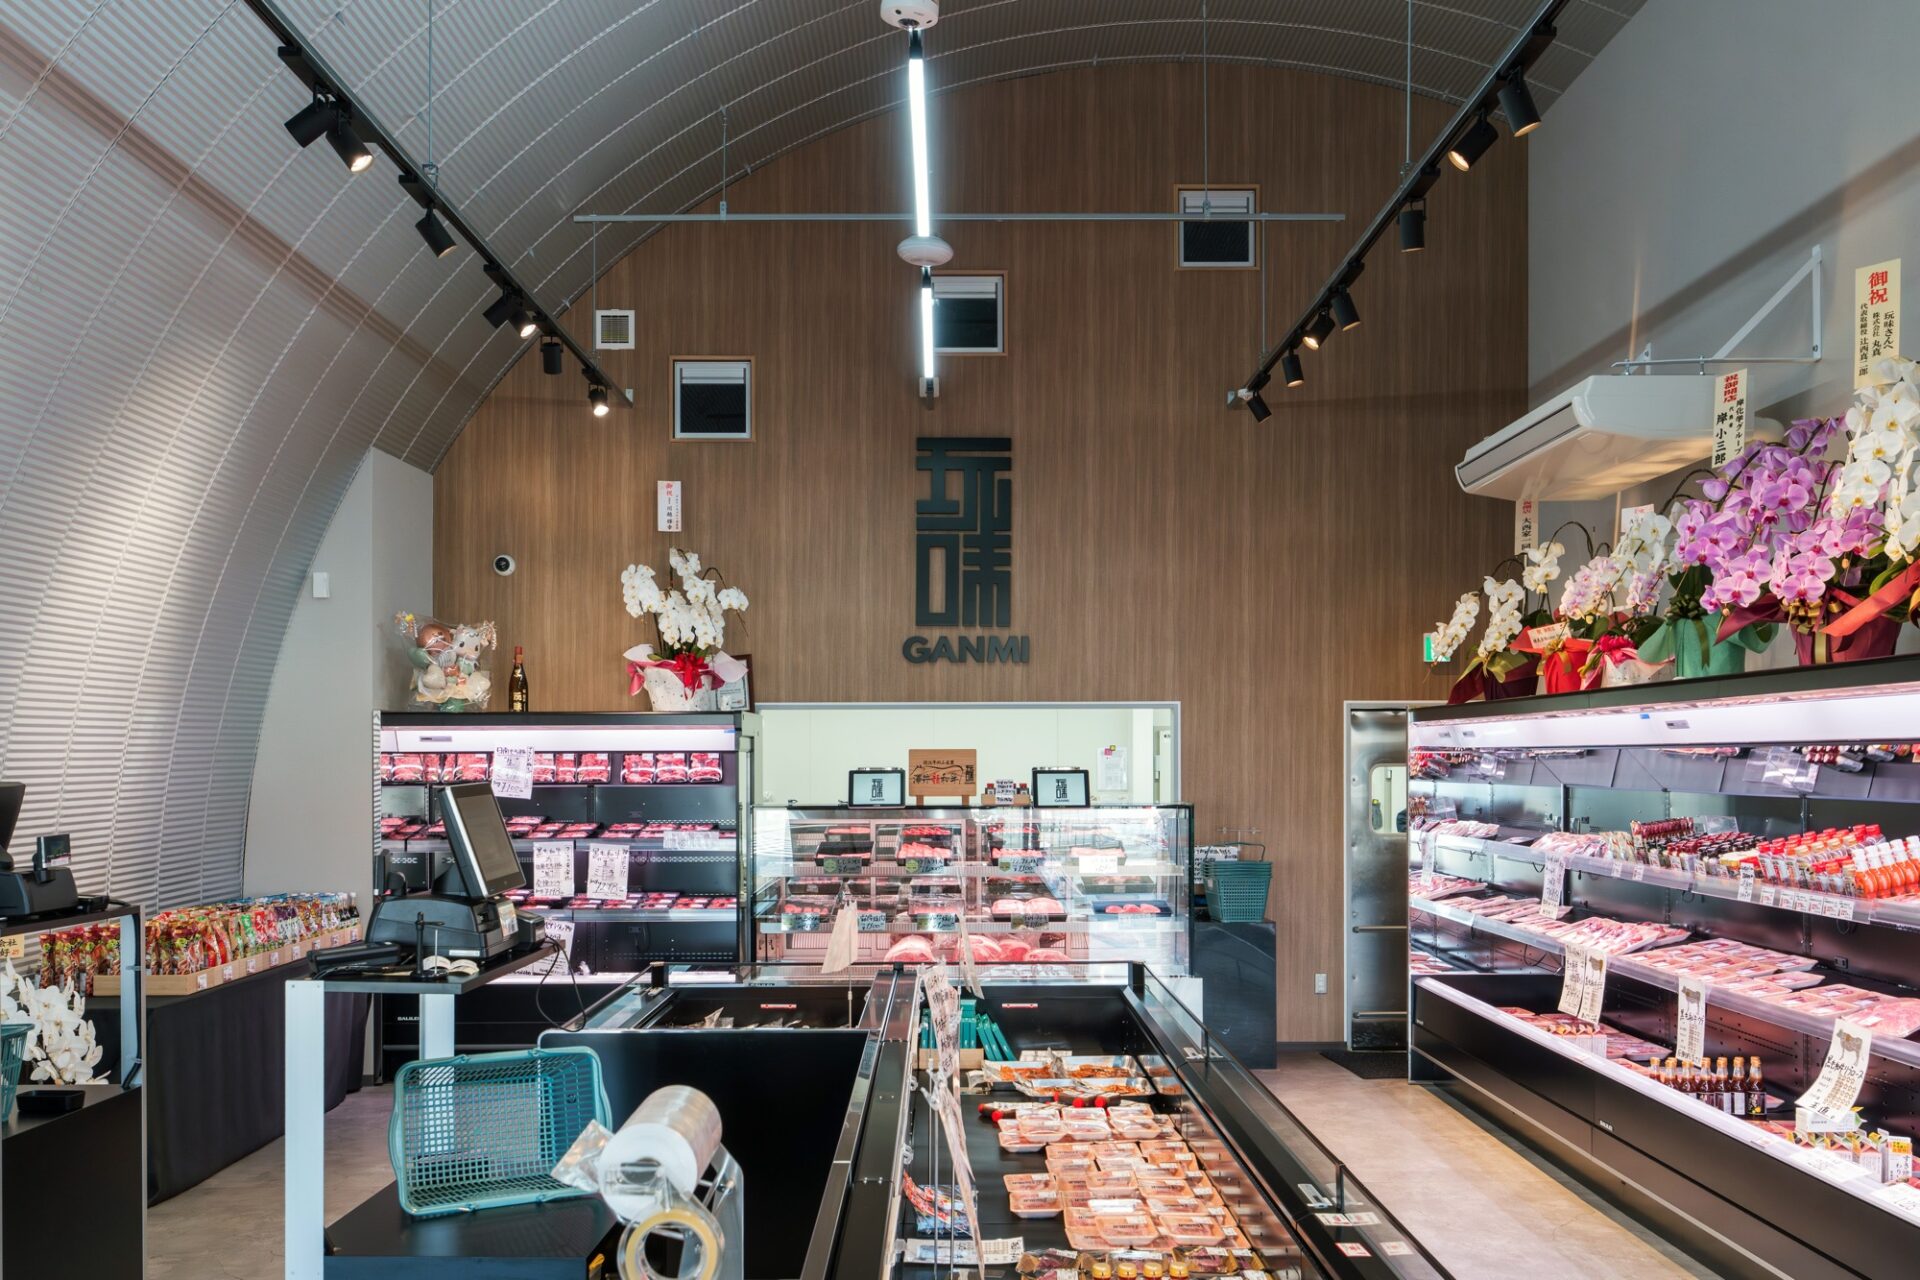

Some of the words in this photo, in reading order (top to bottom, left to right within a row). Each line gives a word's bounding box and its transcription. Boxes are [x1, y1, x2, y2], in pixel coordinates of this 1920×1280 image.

[1868, 270, 1889, 306] 御祝
[1860, 303, 1869, 336] 代表取締役
[1872, 311, 1881, 338] 株式会社
[1883, 311, 1895, 350] 玩味さんへ
[1714, 411, 1728, 465] 岸小三郎
[902, 635, 1031, 665] GANMI
